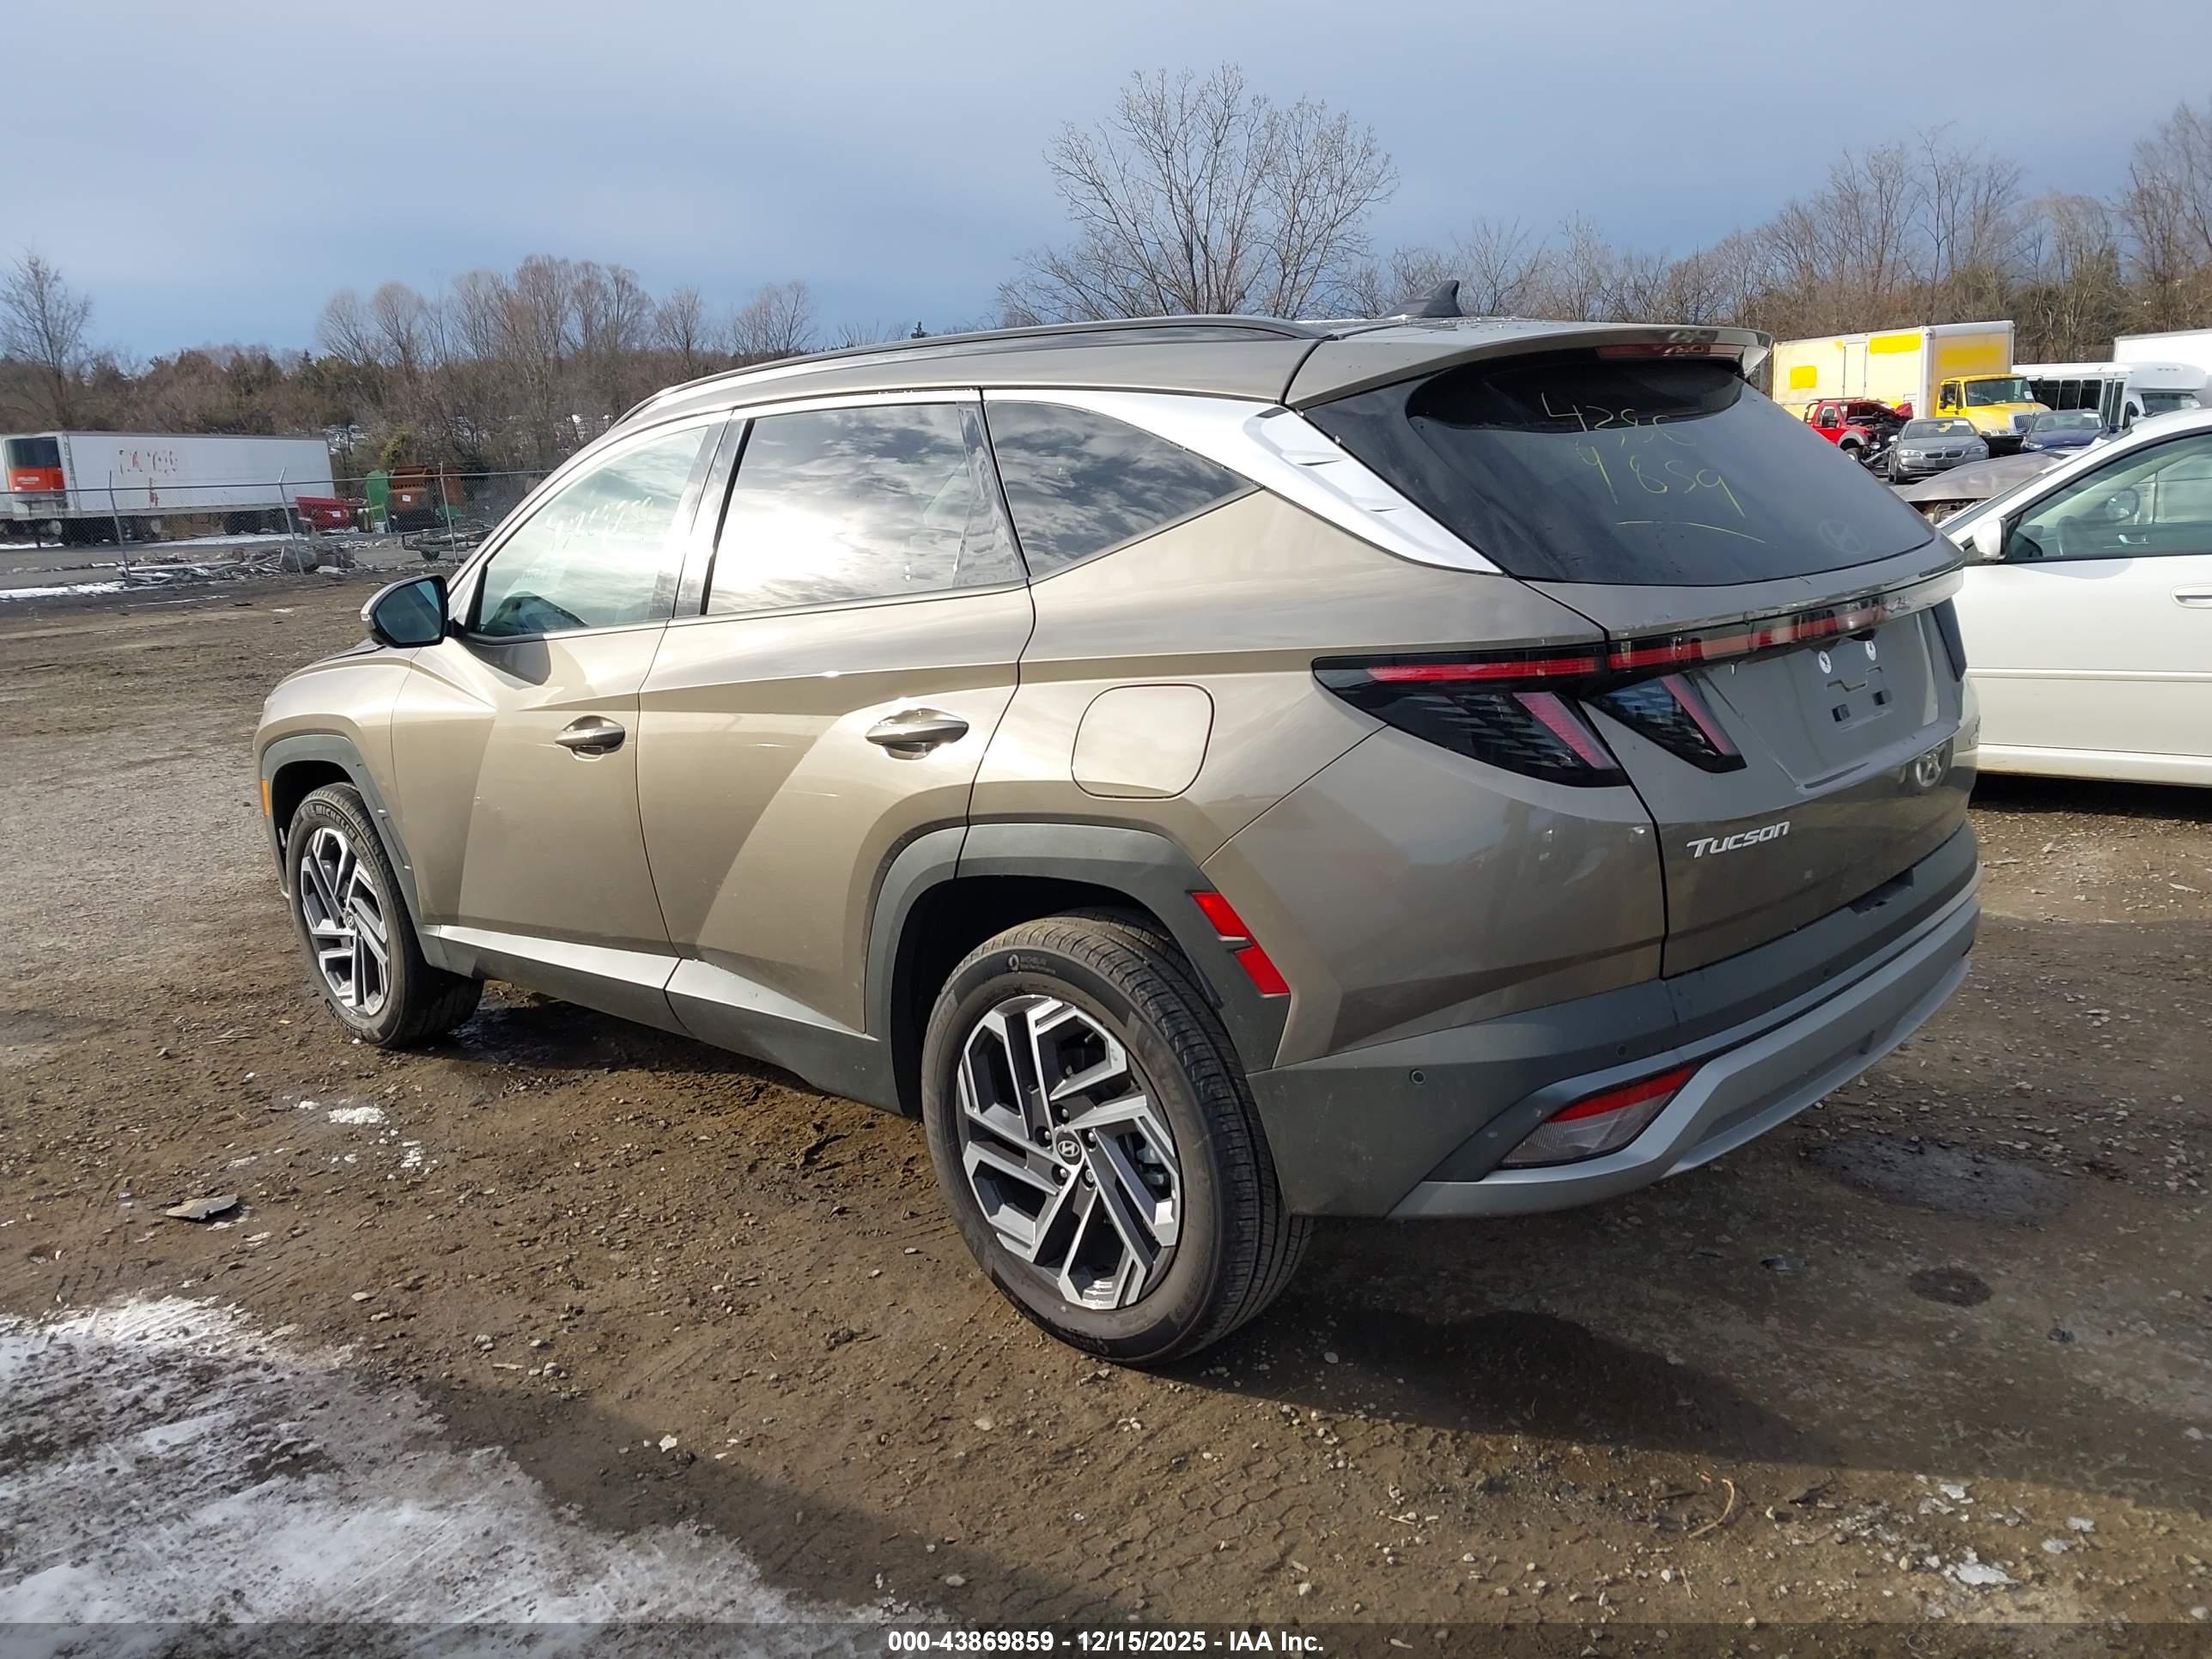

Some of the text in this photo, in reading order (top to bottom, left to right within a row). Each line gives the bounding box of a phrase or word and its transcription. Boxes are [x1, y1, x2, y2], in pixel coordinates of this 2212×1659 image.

[1575, 440, 1746, 518] 9859
[315, 805, 356, 839] MICHELIN
[1686, 821, 1791, 859] Tucson
